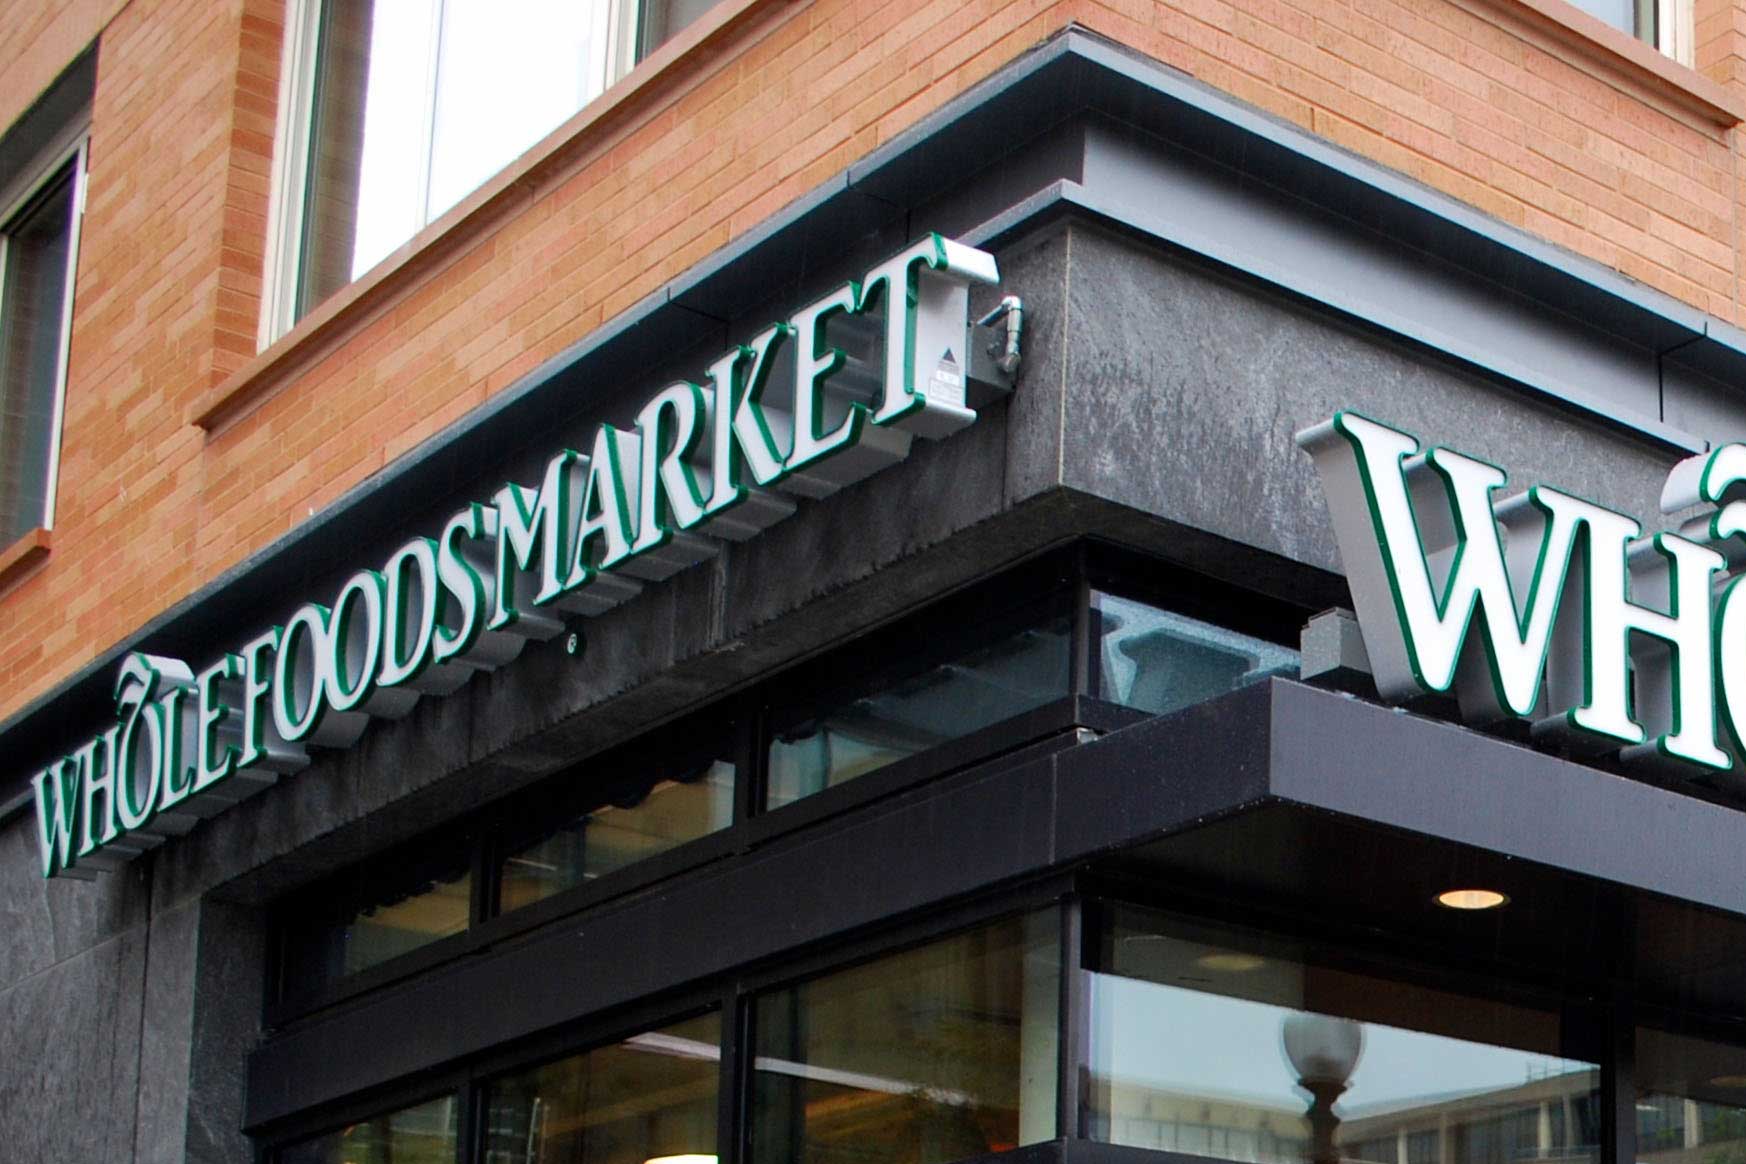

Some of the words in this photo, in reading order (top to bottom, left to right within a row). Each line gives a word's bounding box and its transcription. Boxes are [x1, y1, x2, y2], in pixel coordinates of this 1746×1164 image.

[30, 651, 243, 879] WHOLE
[236, 501, 487, 769] FOODS
[487, 231, 949, 630] MARKET
